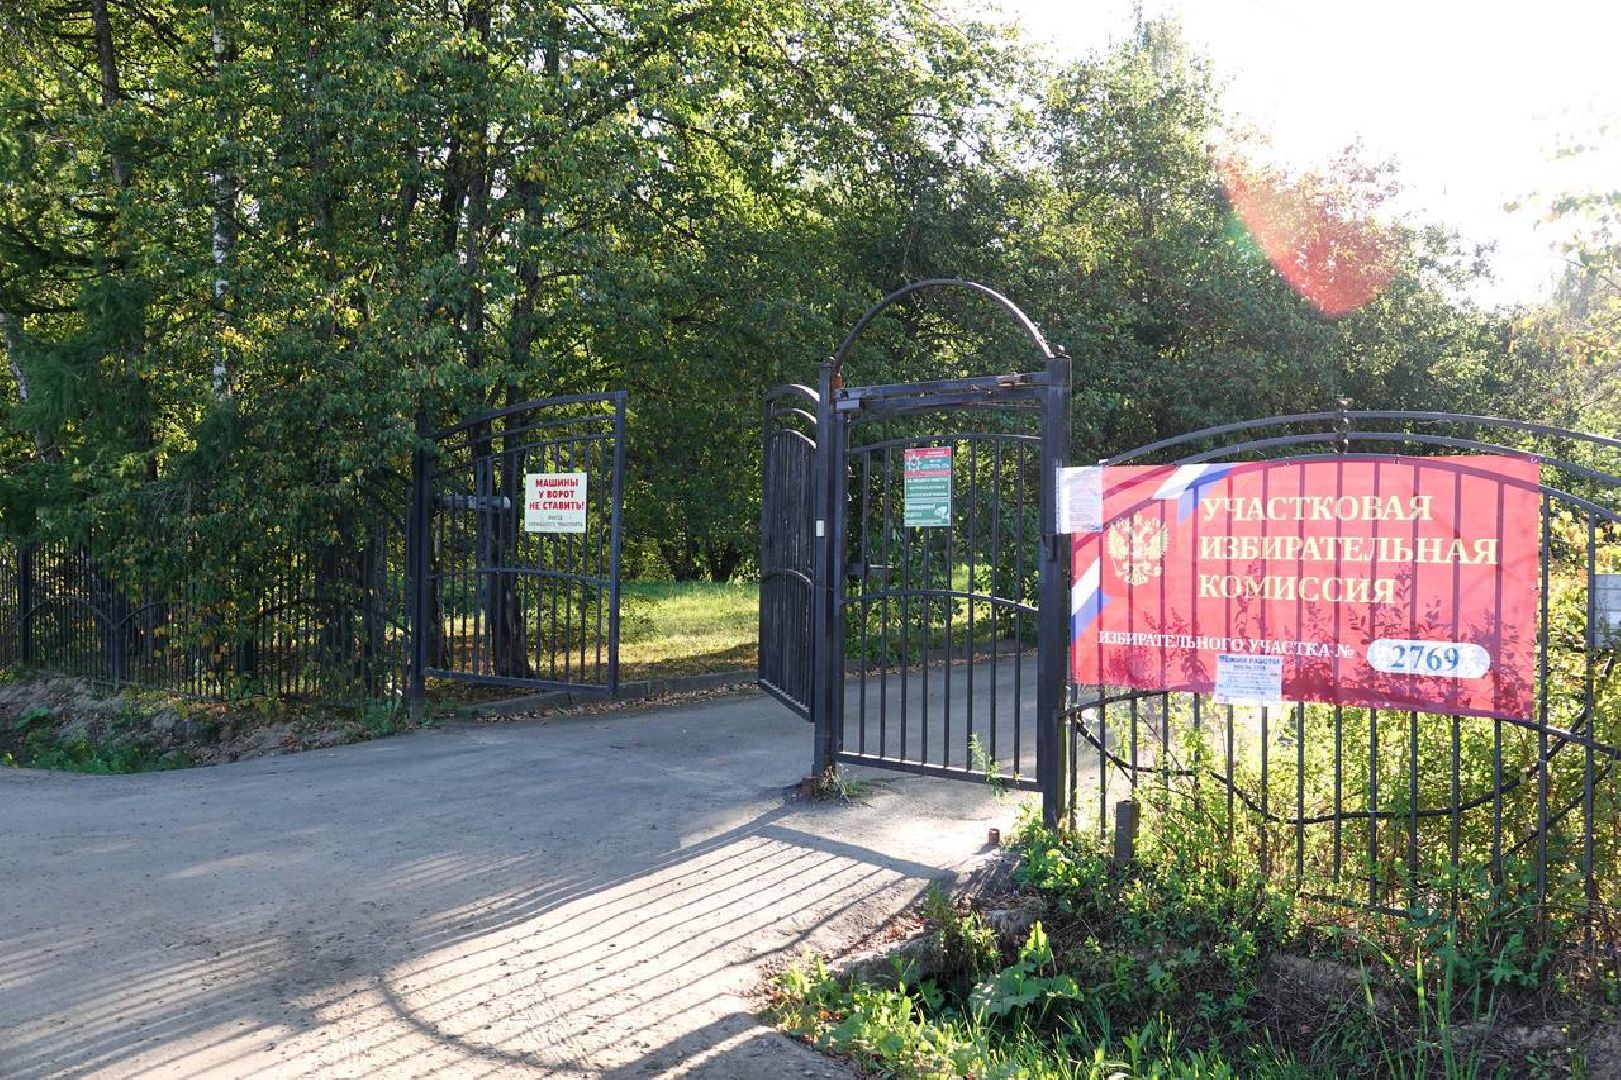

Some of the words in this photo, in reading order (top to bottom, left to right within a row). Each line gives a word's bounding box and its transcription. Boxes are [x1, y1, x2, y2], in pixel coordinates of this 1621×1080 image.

[536, 479, 578, 487] МАШИНЫ
[547, 490, 575, 499] ВОРОТ
[529, 501, 540, 511] НЕ
[543, 501, 585, 511] СТАВИТЬ!
[1200, 495, 1434, 522] УЧАСТКОВАЯ
[1200, 535, 1500, 565] ИЗБИРАТЕЛЬНАЯ
[1200, 575, 1398, 604] КОМИССИЯ
[1099, 630, 1244, 651] ИЗБИРАТЕЛЬНОГО
[1249, 639, 1330, 657] УЧАСТКА
[1335, 644, 1354, 659] №
[1390, 645, 1459, 671] 2769
